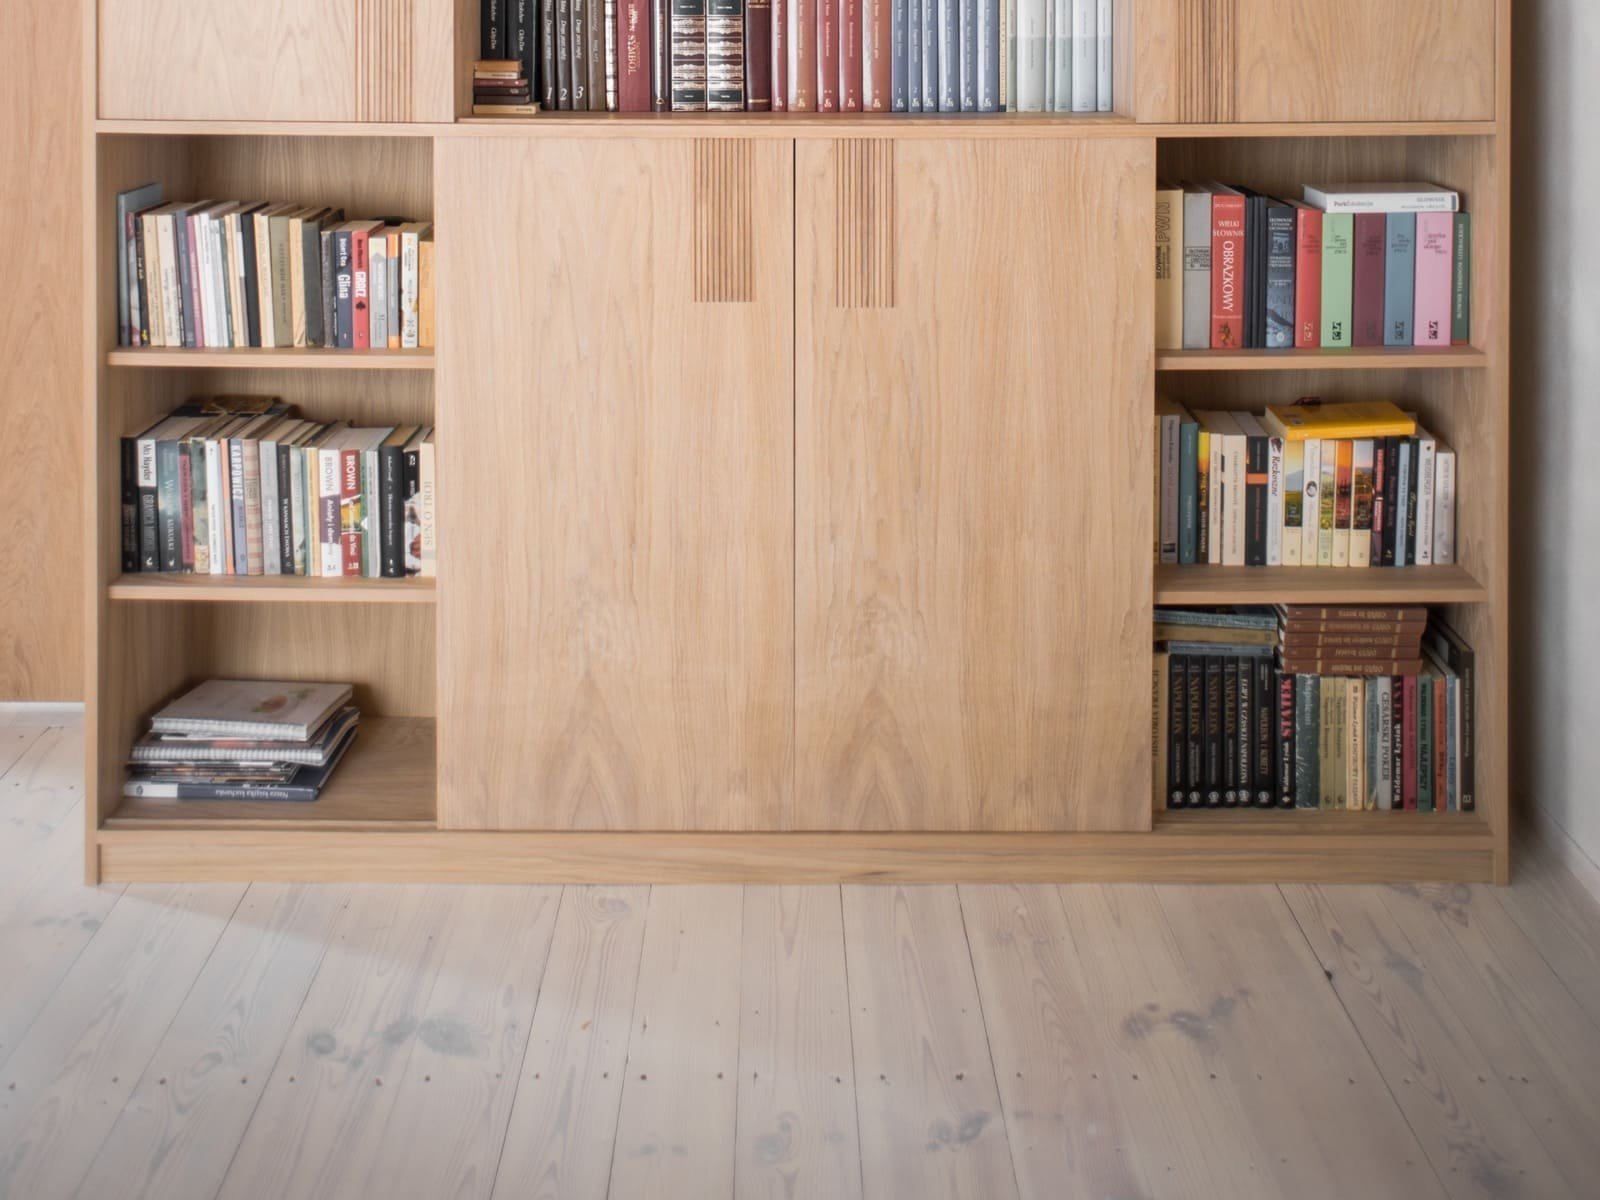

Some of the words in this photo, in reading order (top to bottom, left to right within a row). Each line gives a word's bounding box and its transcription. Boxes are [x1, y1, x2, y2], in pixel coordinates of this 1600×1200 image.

[1222, 240, 1234, 311] OBRAZKOWY
[231, 444, 243, 500] KARPOWICZ
[324, 456, 333, 491] BROWN
[346, 455, 356, 489] BROWN
[1381, 692, 1390, 744] CESARSKI
[1381, 746, 1390, 781] POKER
[1393, 757, 1402, 801] Waldemar
